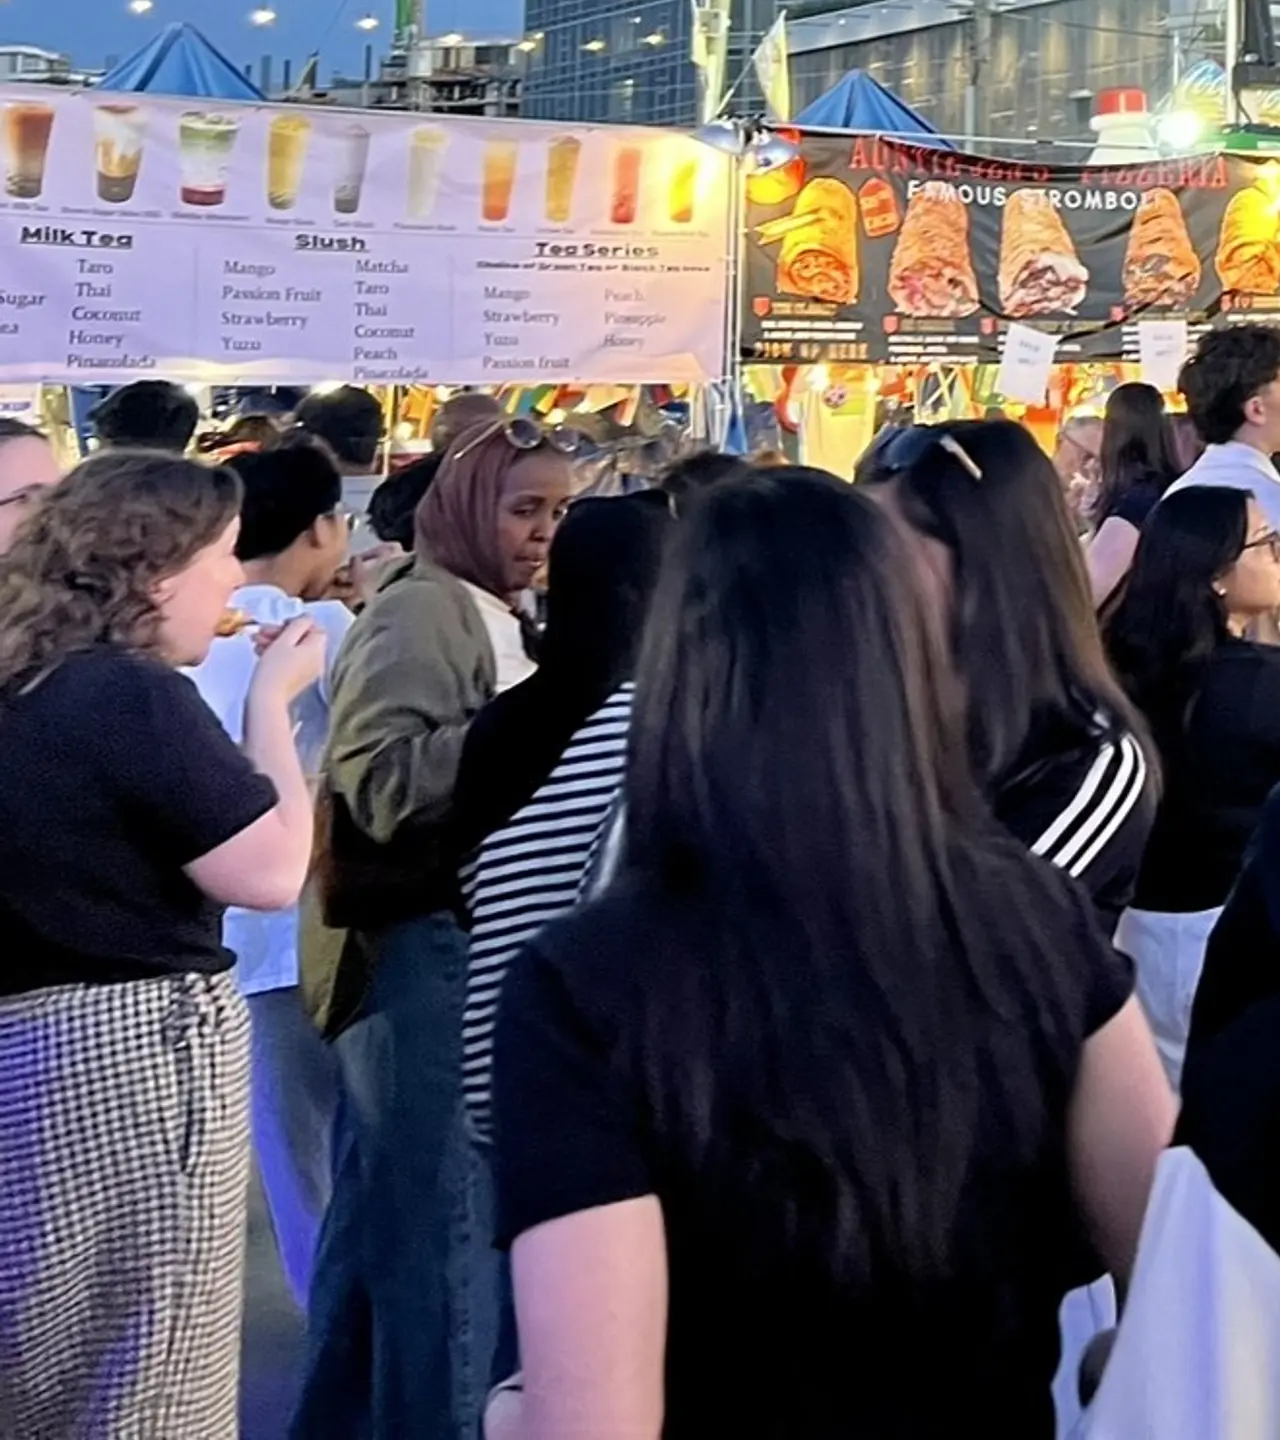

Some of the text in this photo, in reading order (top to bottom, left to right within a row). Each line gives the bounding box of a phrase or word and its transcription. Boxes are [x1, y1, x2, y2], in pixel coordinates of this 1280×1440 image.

[906, 179, 1006, 206] FAMOUS
[20, 226, 133, 247] Milk Tea
[295, 233, 367, 250] Slush
[534, 241, 660, 258] Tea Series
[77, 258, 115, 275] Taro
[223, 260, 277, 279] Mango
[355, 259, 409, 274] Matcha
[75, 282, 112, 299] Thai
[222, 285, 322, 302] Passion Fruit
[354, 280, 390, 295] Taro
[484, 286, 531, 303] Mango
[71, 306, 142, 322] Coconut
[354, 302, 388, 317] Thai
[221, 310, 309, 329] Strawberry
[483, 310, 561, 327] Strawberry
[0, 322, 20, 334] ea
[354, 325, 416, 339] Coconut
[68, 330, 126, 348] Honey
[221, 337, 262, 352] Yuzu
[354, 346, 398, 361] Peach
[483, 356, 570, 371] Passion fruit
